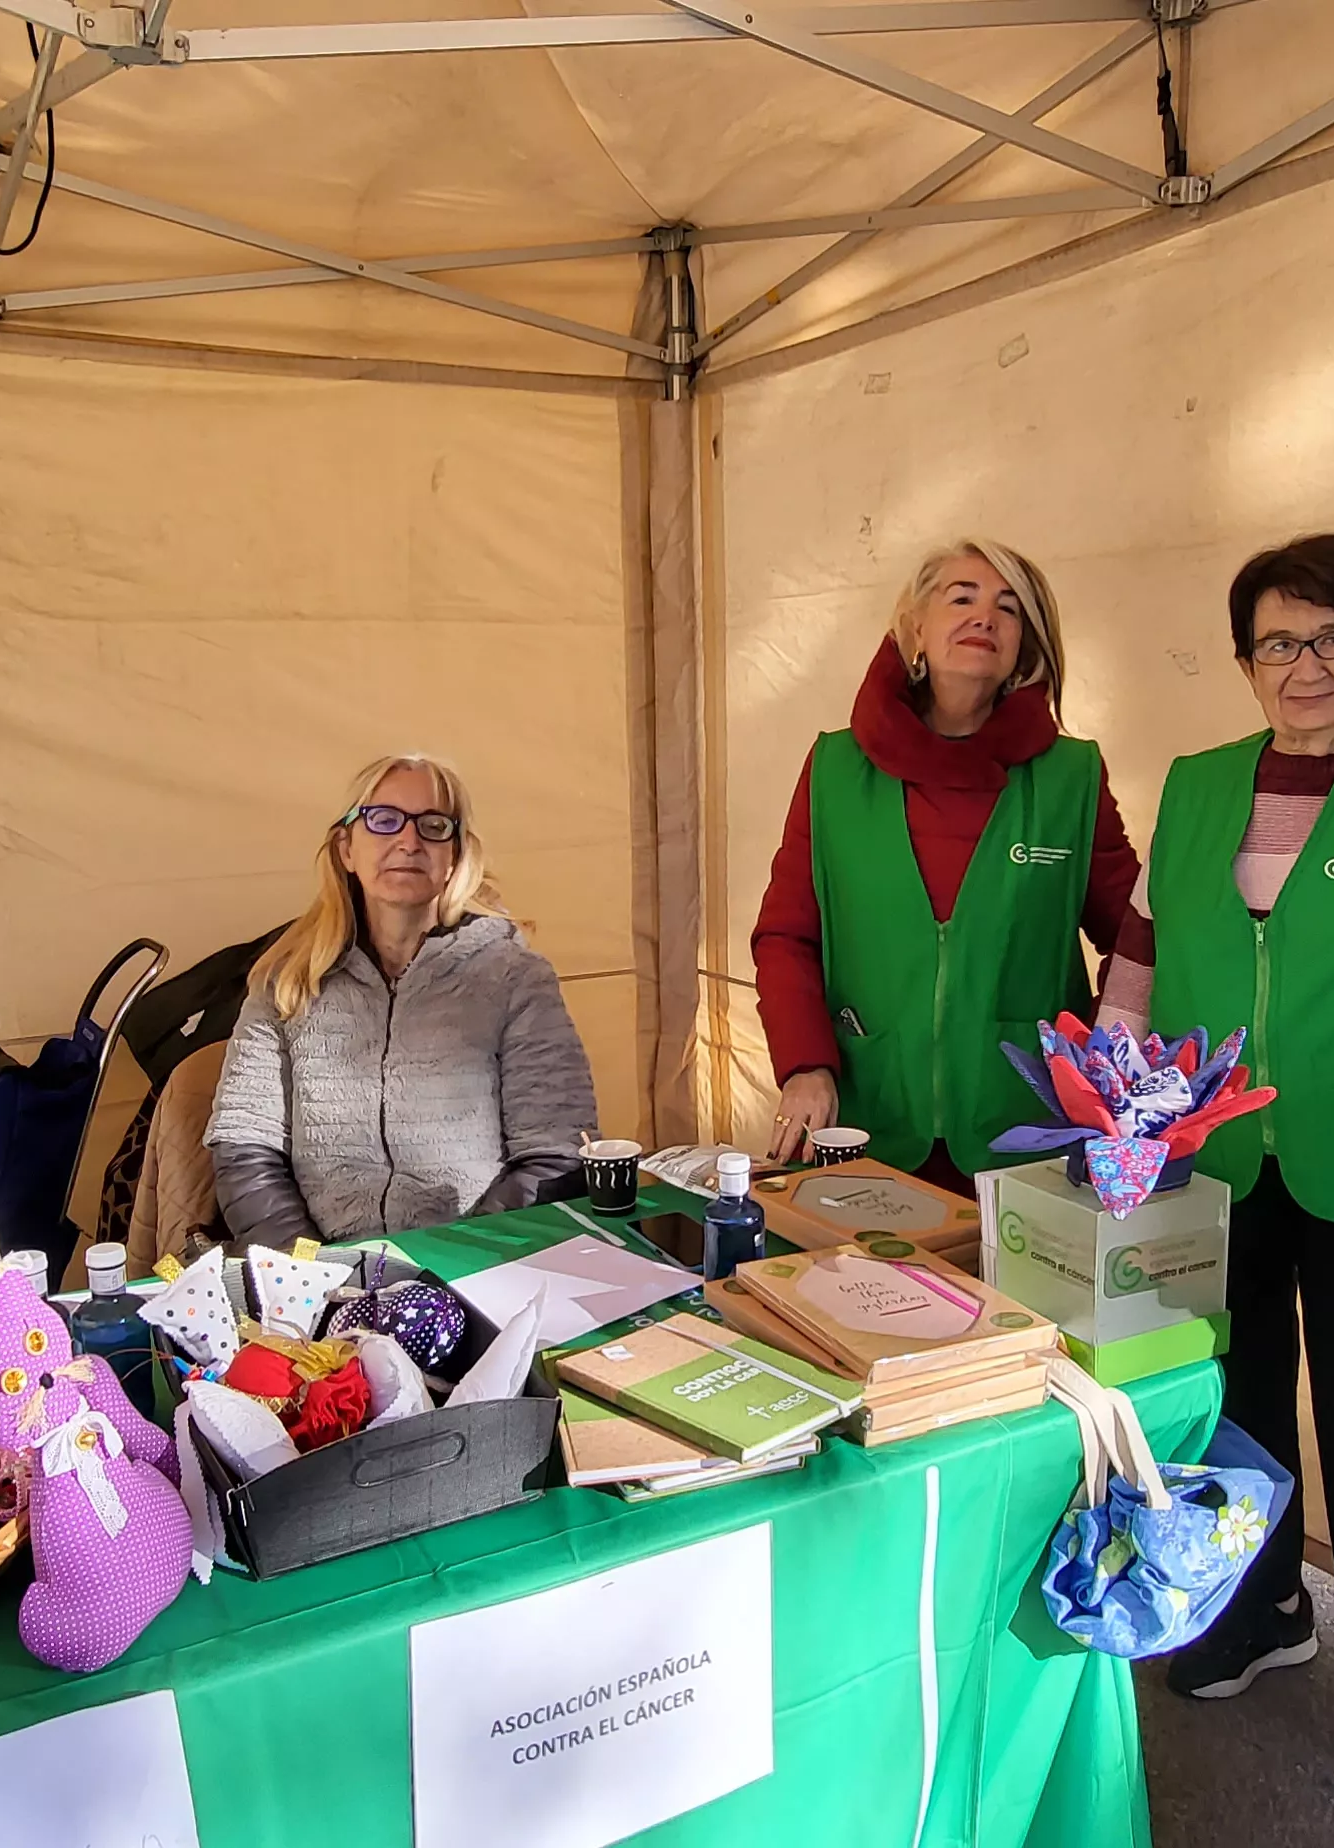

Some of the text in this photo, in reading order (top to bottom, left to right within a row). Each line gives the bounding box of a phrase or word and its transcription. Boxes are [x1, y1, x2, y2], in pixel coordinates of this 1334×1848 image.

[1030, 1251, 1057, 1269] contra
[1057, 1263, 1066, 1274] el
[1148, 1268, 1177, 1282] contra
[839, 1280, 886, 1294] better
[685, 1367, 763, 1402] DOY LA CAR
[768, 1390, 809, 1412] aecc
[490, 1650, 712, 1738] ASOCIACIÓN ESPAÑOLA
[512, 1688, 695, 1765] CONTRA EL CÁNCER
